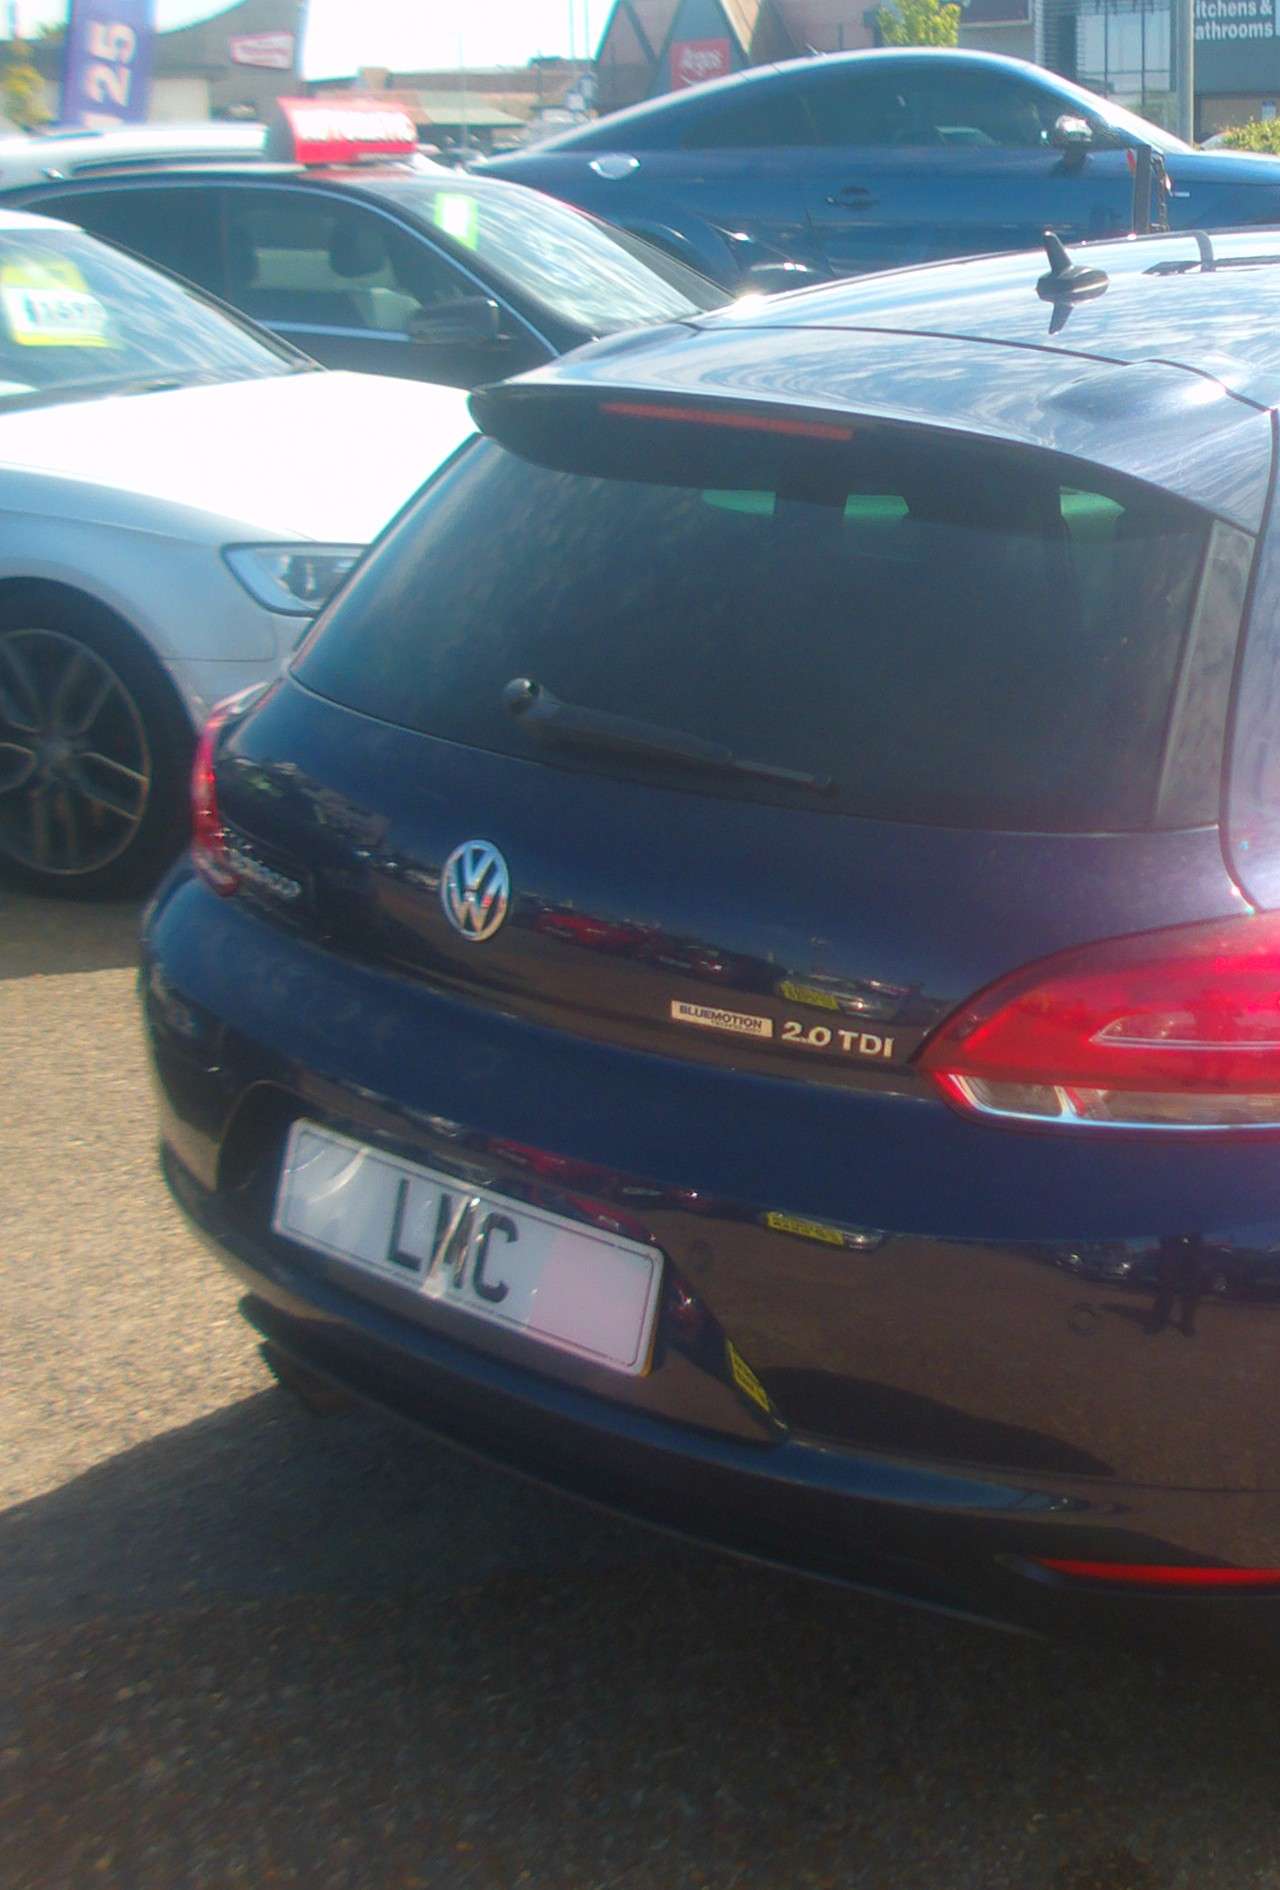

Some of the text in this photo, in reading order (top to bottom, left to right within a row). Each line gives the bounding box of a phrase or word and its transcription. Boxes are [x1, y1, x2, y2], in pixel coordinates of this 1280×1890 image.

[1195, 0, 1272, 19] itchens &
[1195, 21, 1274, 41] athrooms
[679, 1003, 763, 1030] BLUEMOTION
[781, 1020, 832, 1047] 2.0
[838, 1029, 895, 1058] TDI
